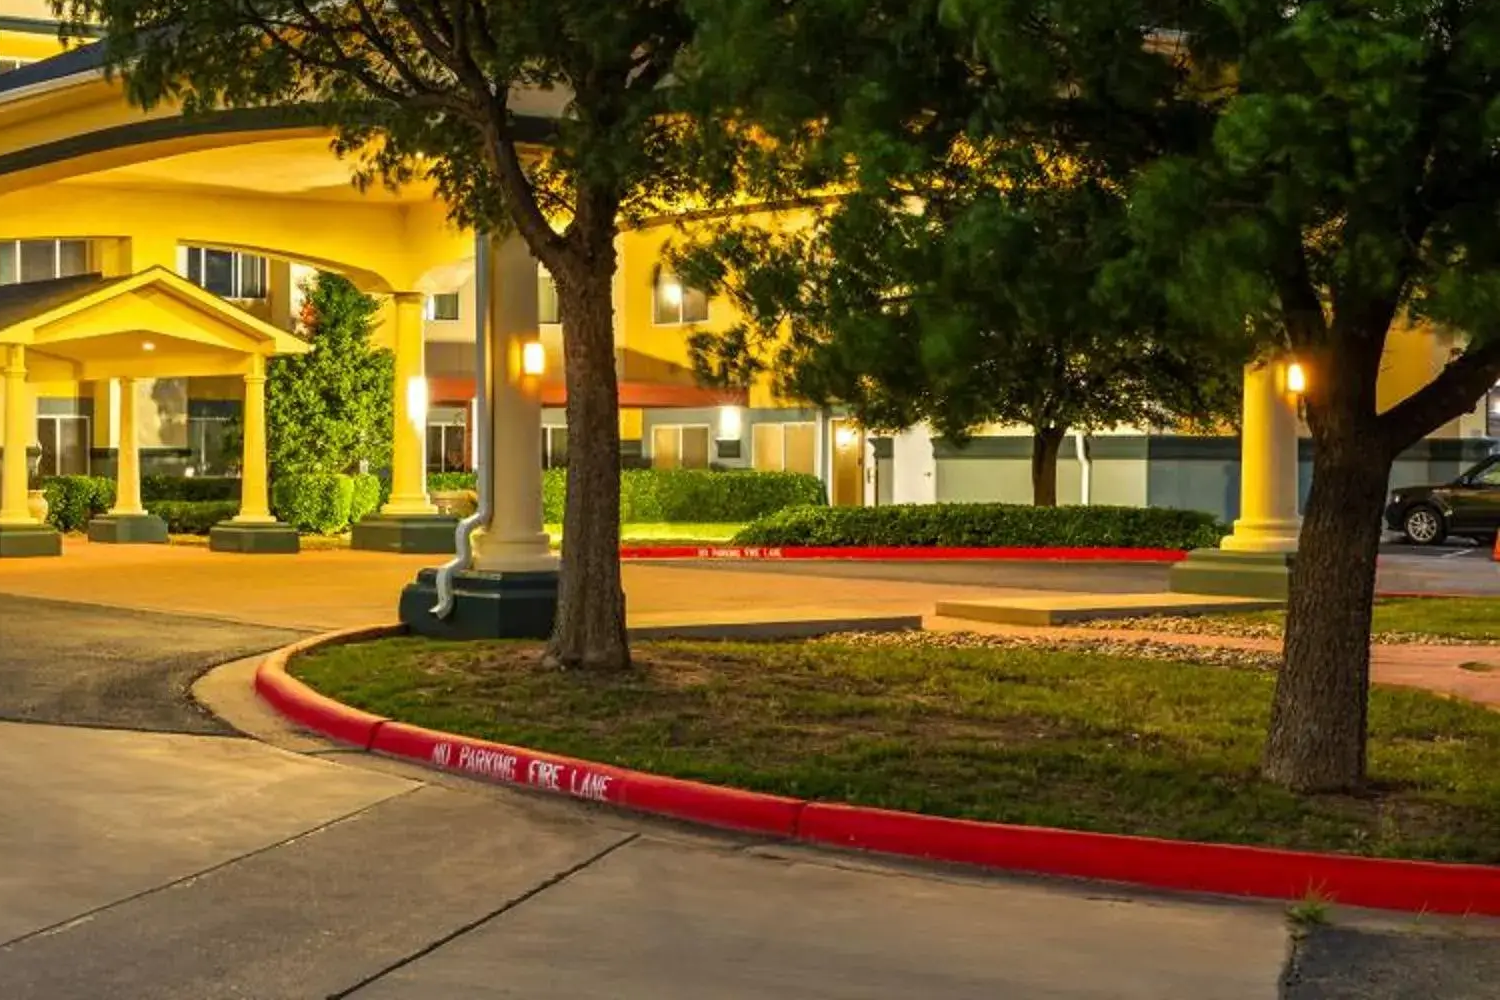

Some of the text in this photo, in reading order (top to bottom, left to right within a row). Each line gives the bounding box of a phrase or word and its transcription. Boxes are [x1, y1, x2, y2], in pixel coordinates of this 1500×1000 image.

[432, 743, 613, 801] NO PARKING FIRE LANE
